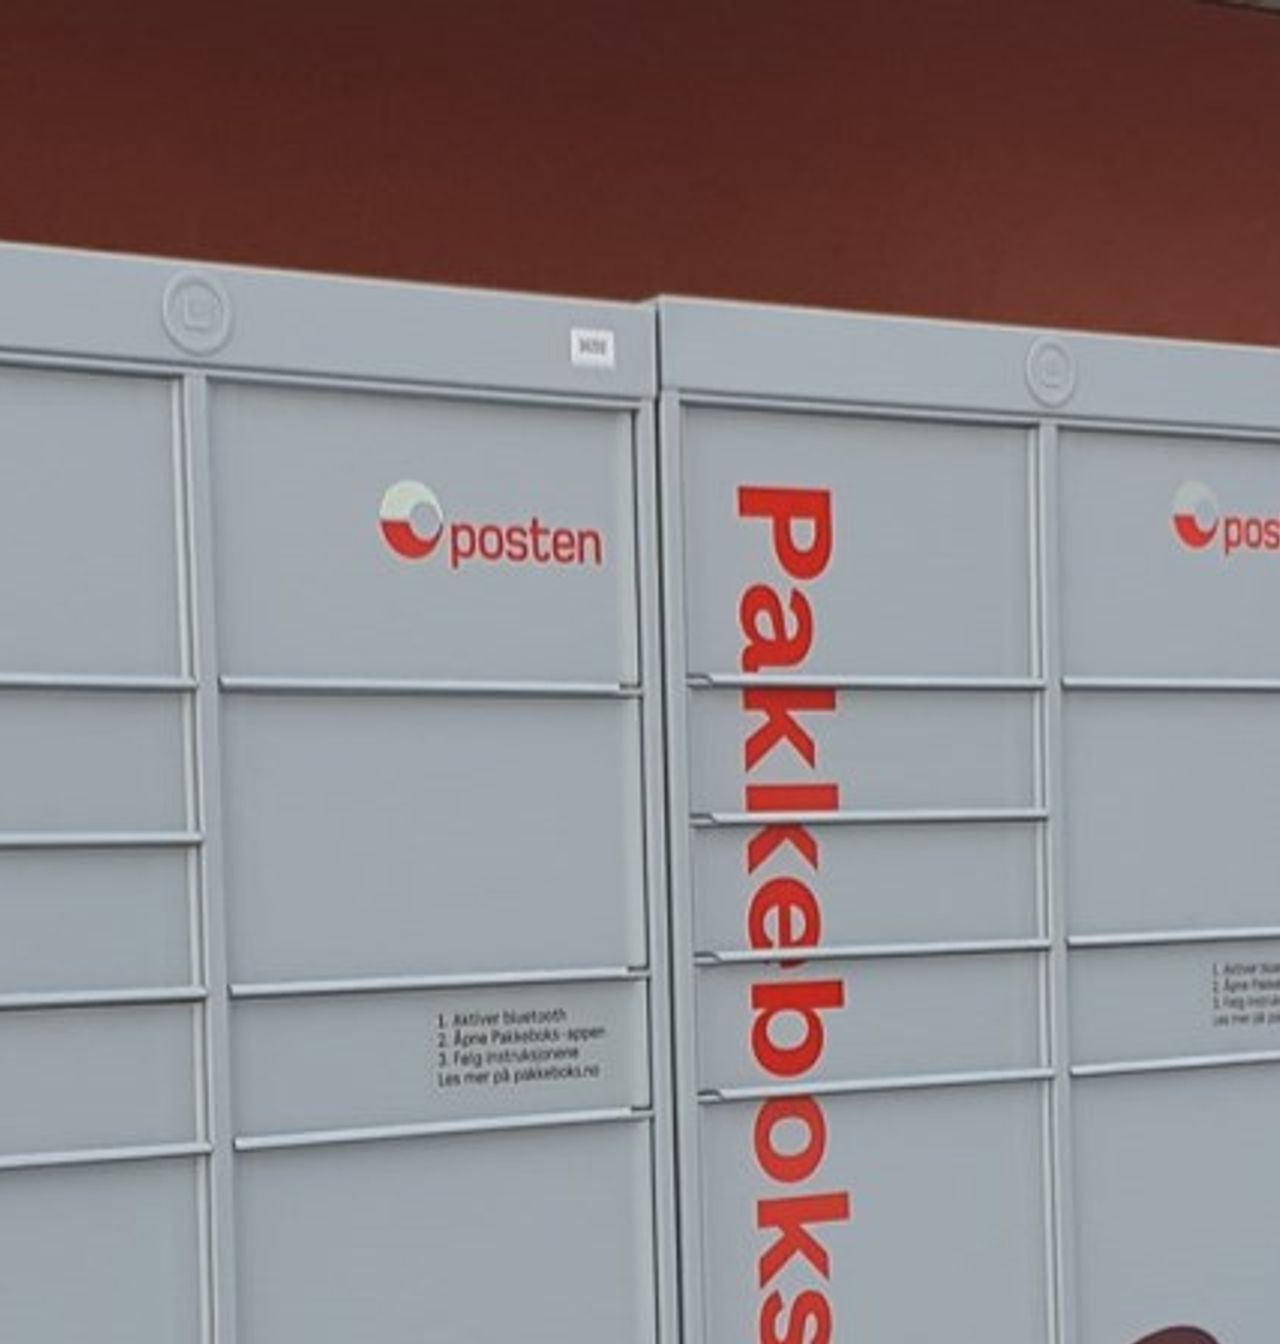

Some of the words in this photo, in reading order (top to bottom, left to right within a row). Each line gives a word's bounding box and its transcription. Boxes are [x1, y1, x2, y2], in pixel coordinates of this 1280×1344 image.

[450, 517, 602, 569] posten
[453, 1012, 500, 1027] Aktiver
[453, 1029, 488, 1048] Åpne
[437, 1072, 461, 1087] Les
